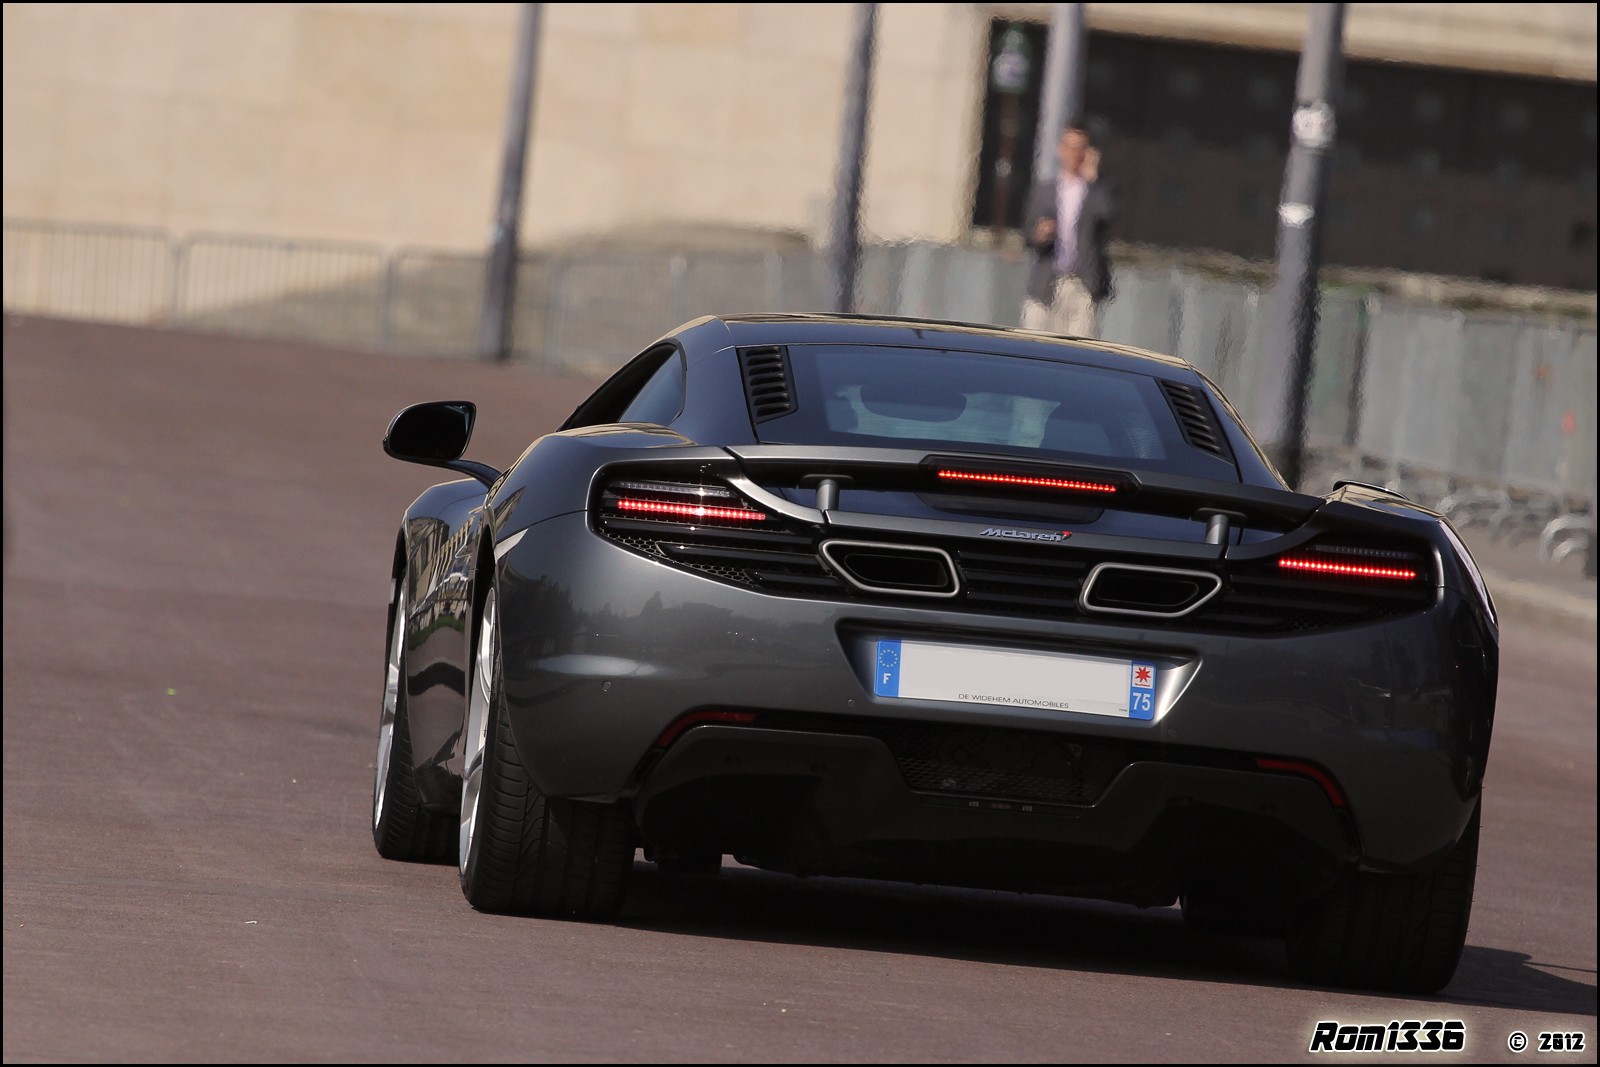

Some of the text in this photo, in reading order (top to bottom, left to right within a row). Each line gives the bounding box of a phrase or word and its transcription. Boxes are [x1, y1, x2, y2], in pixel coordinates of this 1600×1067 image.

[883, 673, 891, 684] F
[972, 694, 1011, 704] WIDEHEM
[1012, 697, 1069, 709] AUTOMOBILES
[1132, 692, 1151, 711] 75
